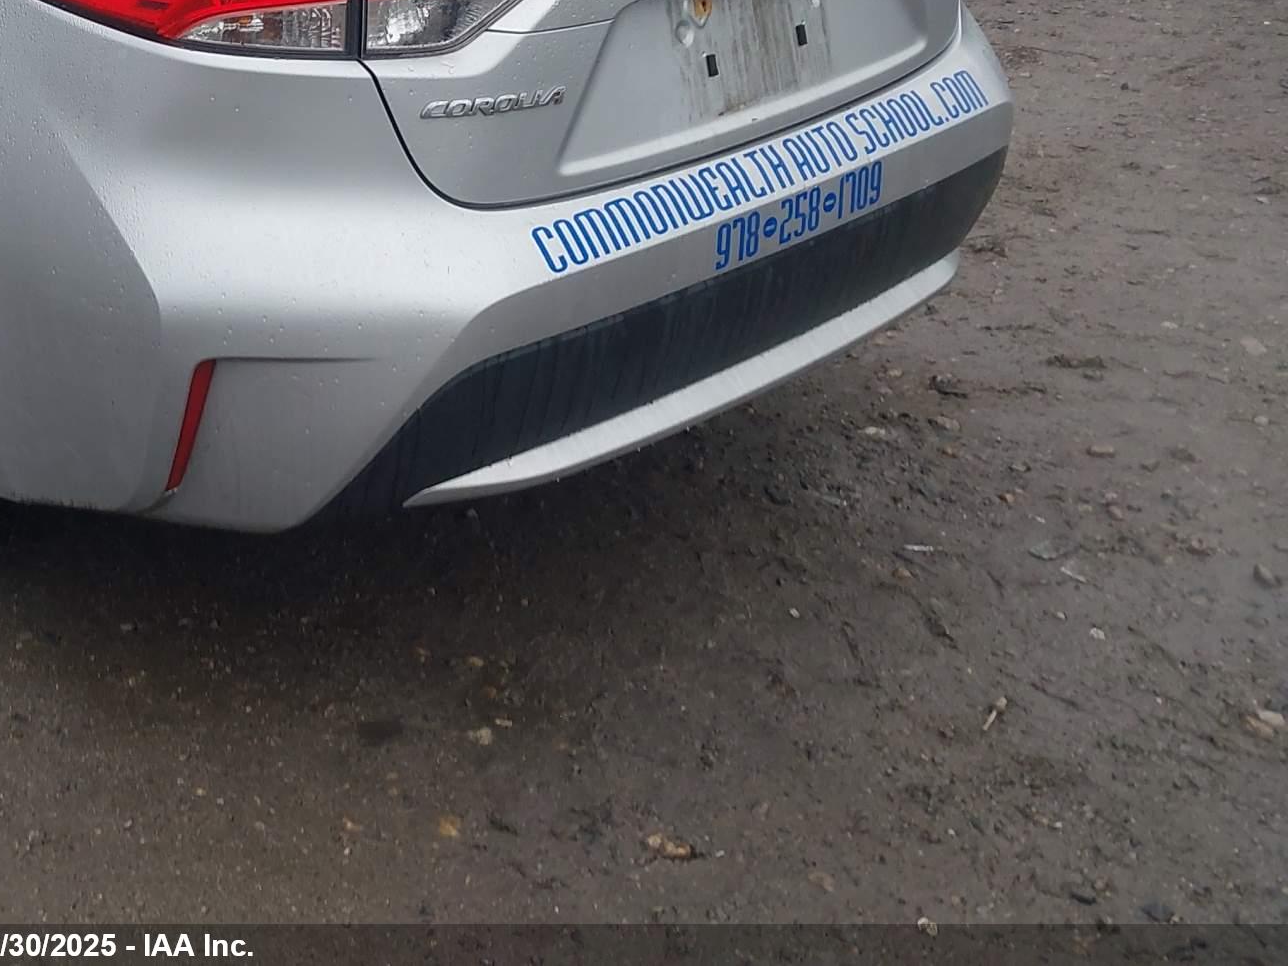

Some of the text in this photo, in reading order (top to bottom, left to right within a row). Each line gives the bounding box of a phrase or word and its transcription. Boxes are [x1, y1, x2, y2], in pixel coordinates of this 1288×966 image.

[420, 86, 566, 119] COROLLA
[531, 70, 989, 273] COMMONWEALTH AUTO SCHOOL.COM
